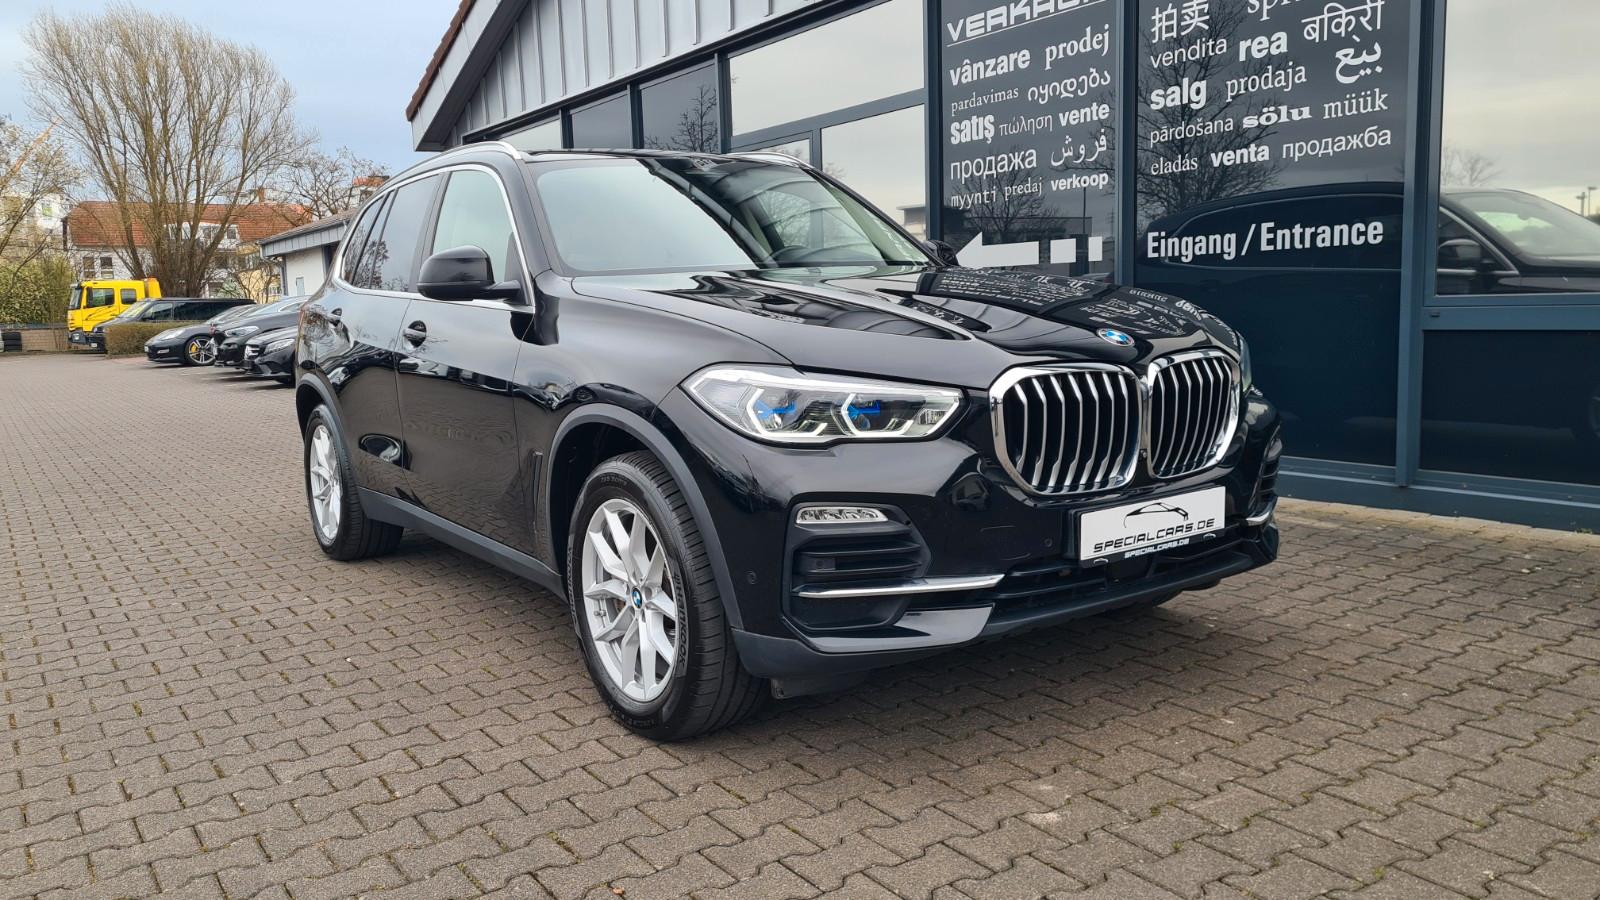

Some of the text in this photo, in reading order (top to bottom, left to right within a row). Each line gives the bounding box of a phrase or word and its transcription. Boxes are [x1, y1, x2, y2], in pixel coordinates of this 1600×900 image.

[947, 0, 1091, 41] VERKA
[1151, 0, 1210, 43] 拍卖
[950, 24, 1110, 86] vânzare prodej
[1151, 31, 1288, 68] vendita rea
[1335, 41, 1383, 84] بيع
[951, 87, 1019, 116] pardavimas
[1027, 68, 1111, 104] იყიდება
[1150, 61, 1307, 110] salg prodaja
[999, 115, 1053, 136] πώληση
[1058, 102, 1110, 127] vente
[1150, 88, 1388, 148] pārdošana sölu müük
[1150, 143, 1270, 176] eladás venta
[1282, 125, 1391, 162] продажба
[950, 149, 1037, 184] продажа
[950, 172, 1109, 210] myynti predaj verkoop
[1147, 231, 1236, 263] Eingang
[1260, 221, 1384, 251] Entrance
[1093, 518, 1216, 553] SPECIALCARS.DE
